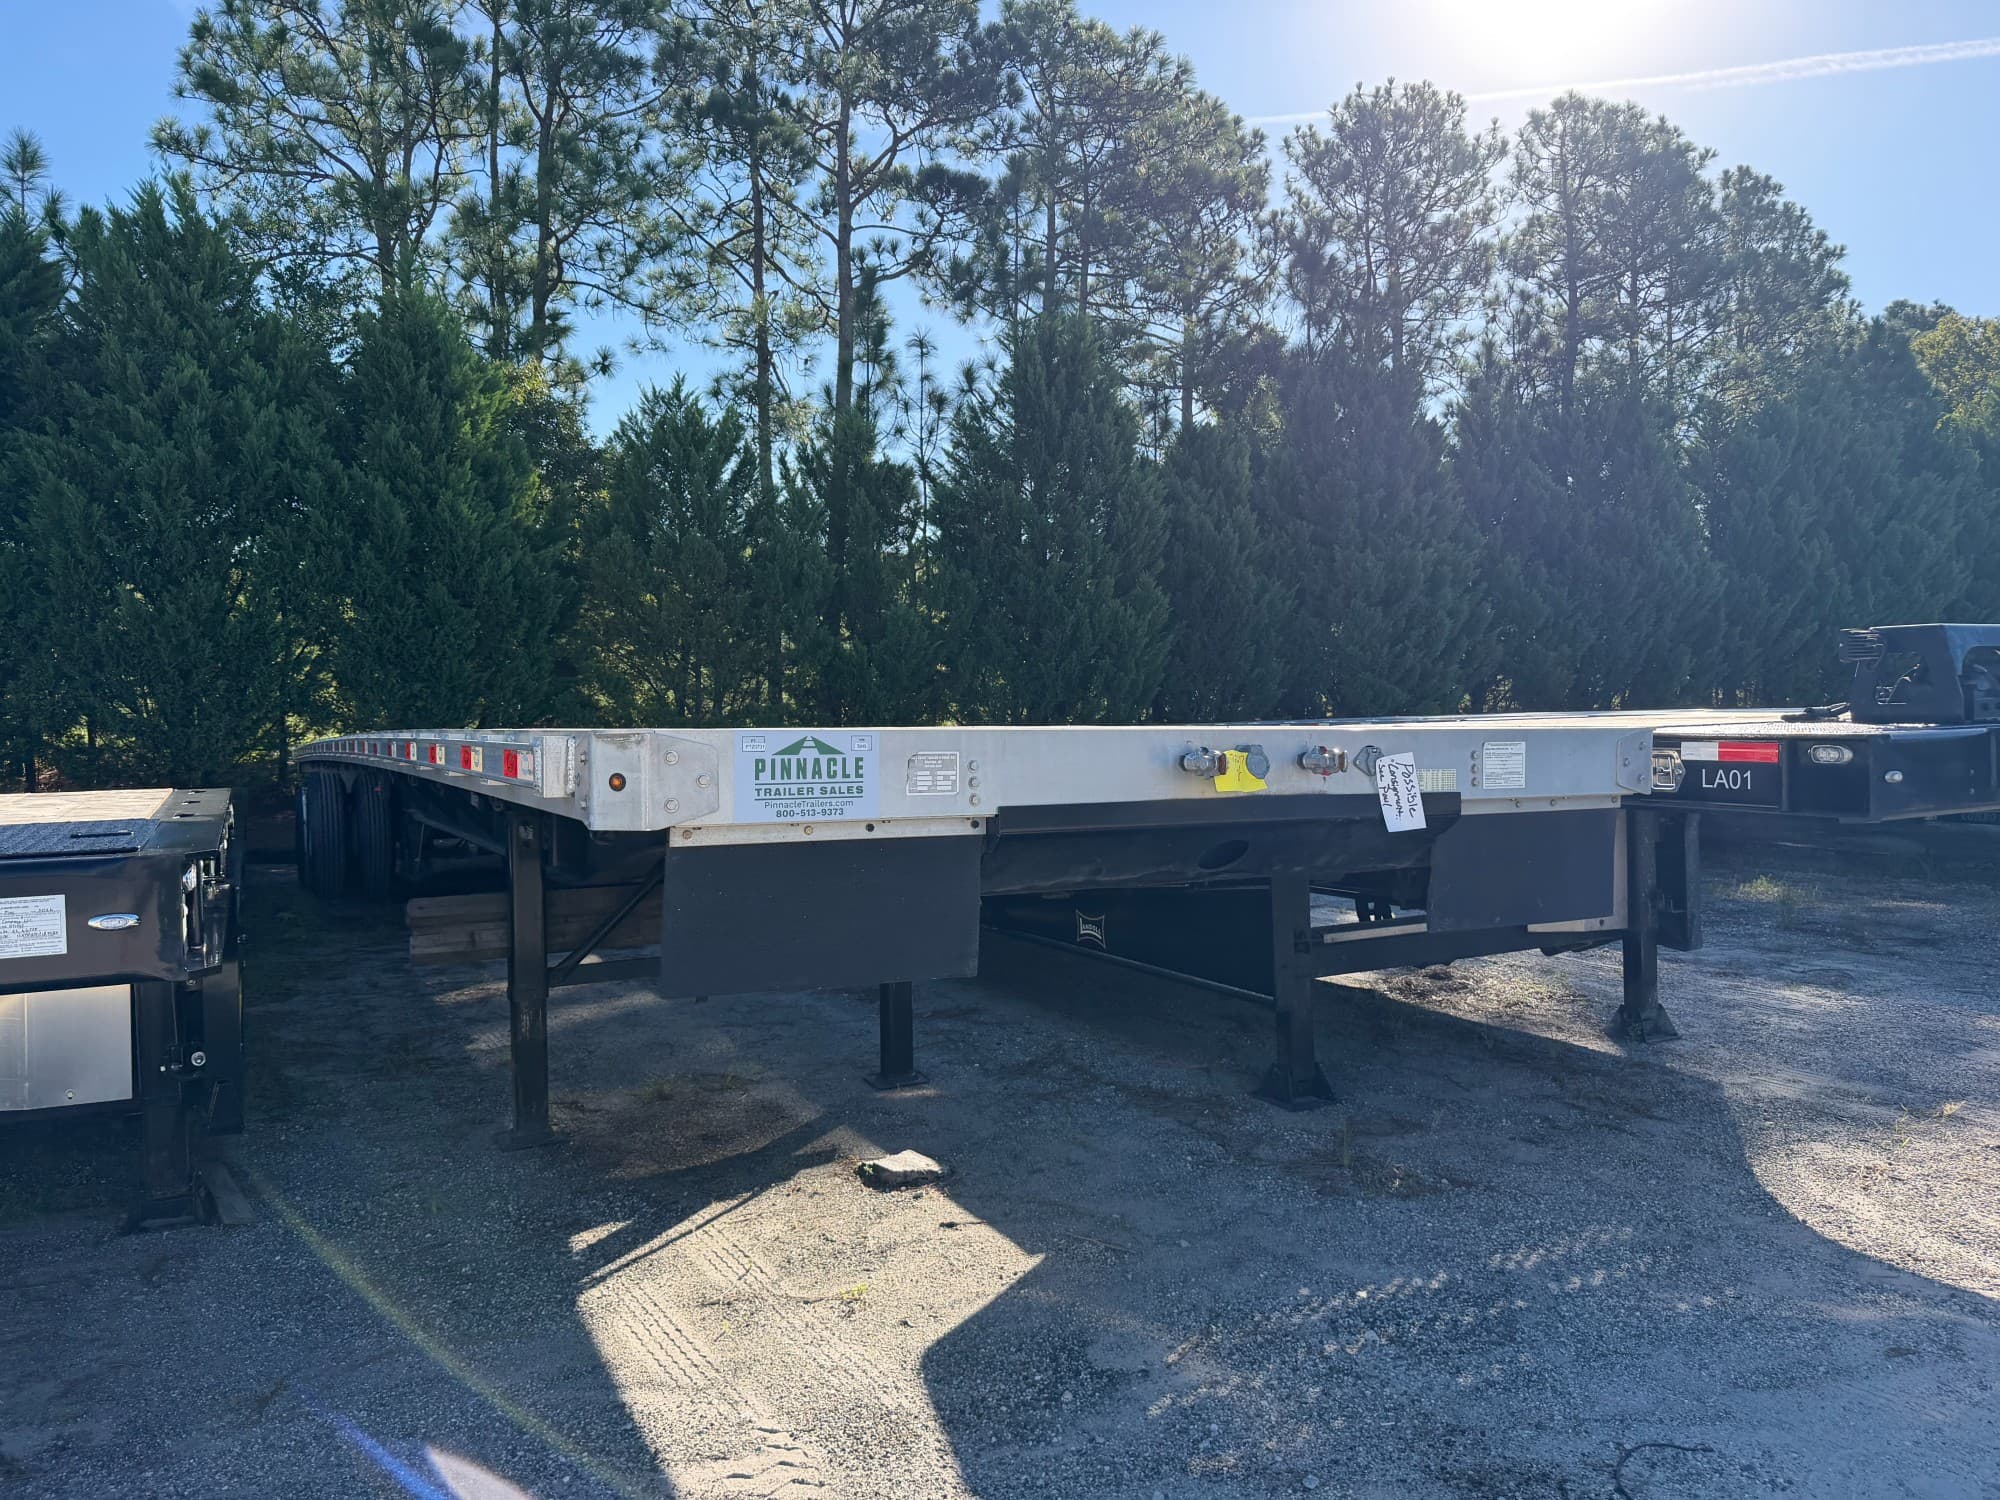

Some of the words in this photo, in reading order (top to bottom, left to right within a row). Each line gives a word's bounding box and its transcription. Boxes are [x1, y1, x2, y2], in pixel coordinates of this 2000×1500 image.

[755, 757, 864, 781] PINNACLE
[1702, 768, 1751, 790] LA01
[755, 787, 814, 797] TRAILER
[819, 785, 864, 795] SALES
[1395, 762, 1418, 819] Possible
[764, 799, 854, 809] PinnacleTrailers.com
[776, 808, 844, 818] 800-513-9373
